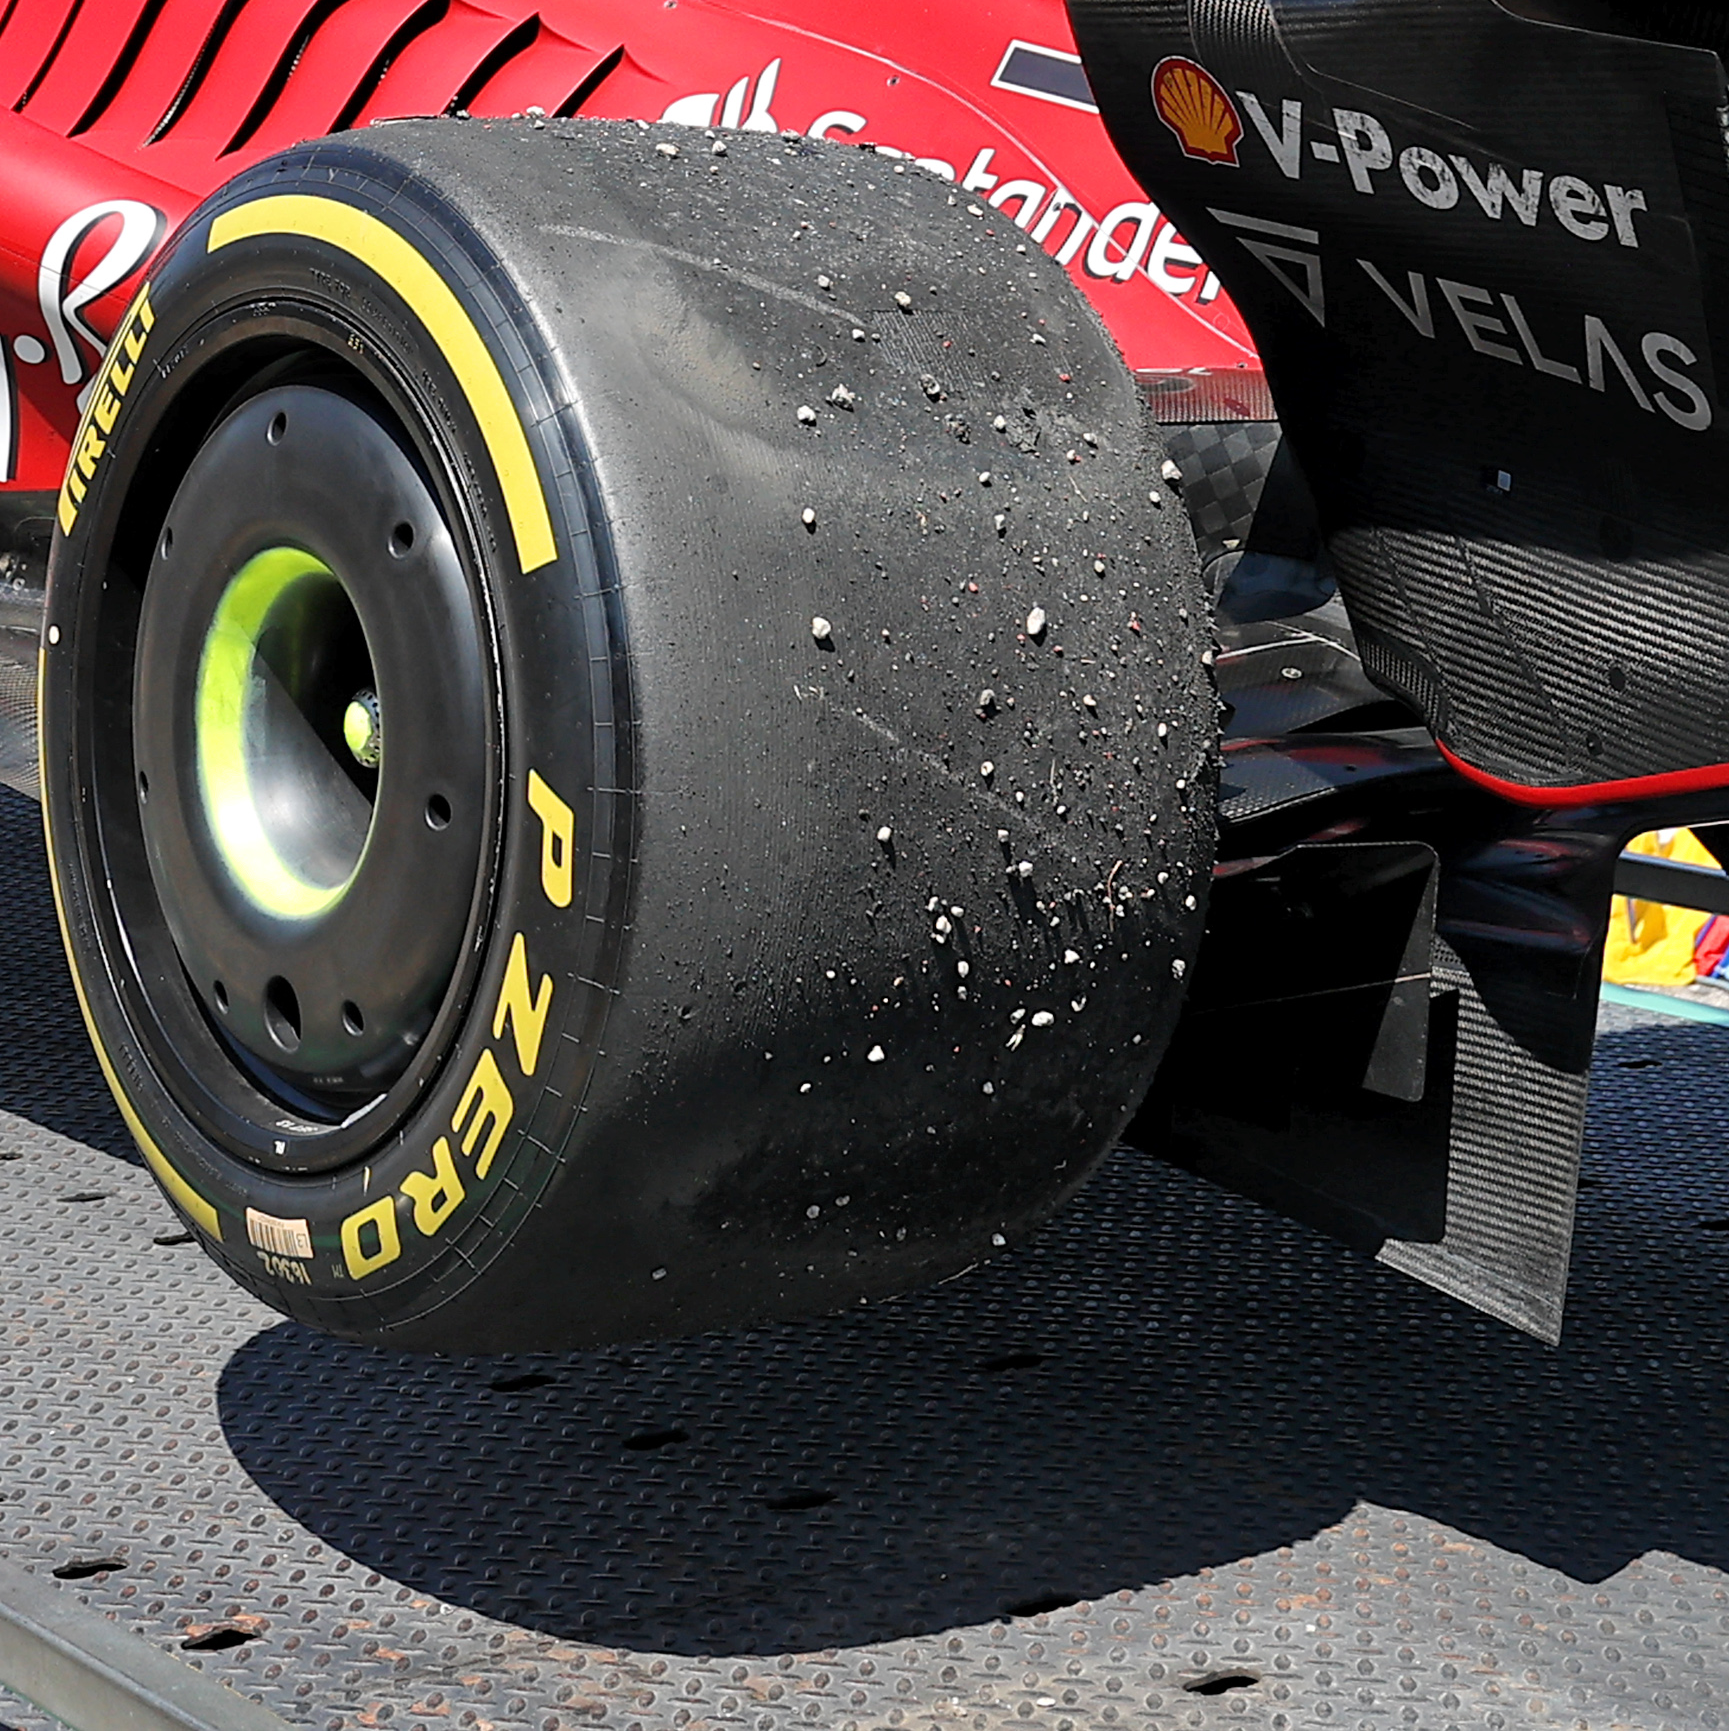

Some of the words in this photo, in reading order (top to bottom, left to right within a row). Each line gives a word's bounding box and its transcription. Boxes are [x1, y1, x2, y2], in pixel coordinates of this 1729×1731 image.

[1234, 90, 1648, 250] V-Power
[1356, 258, 1714, 433] VELAS
[527, 768, 574, 909] P
[340, 931, 554, 1281] ZERO
